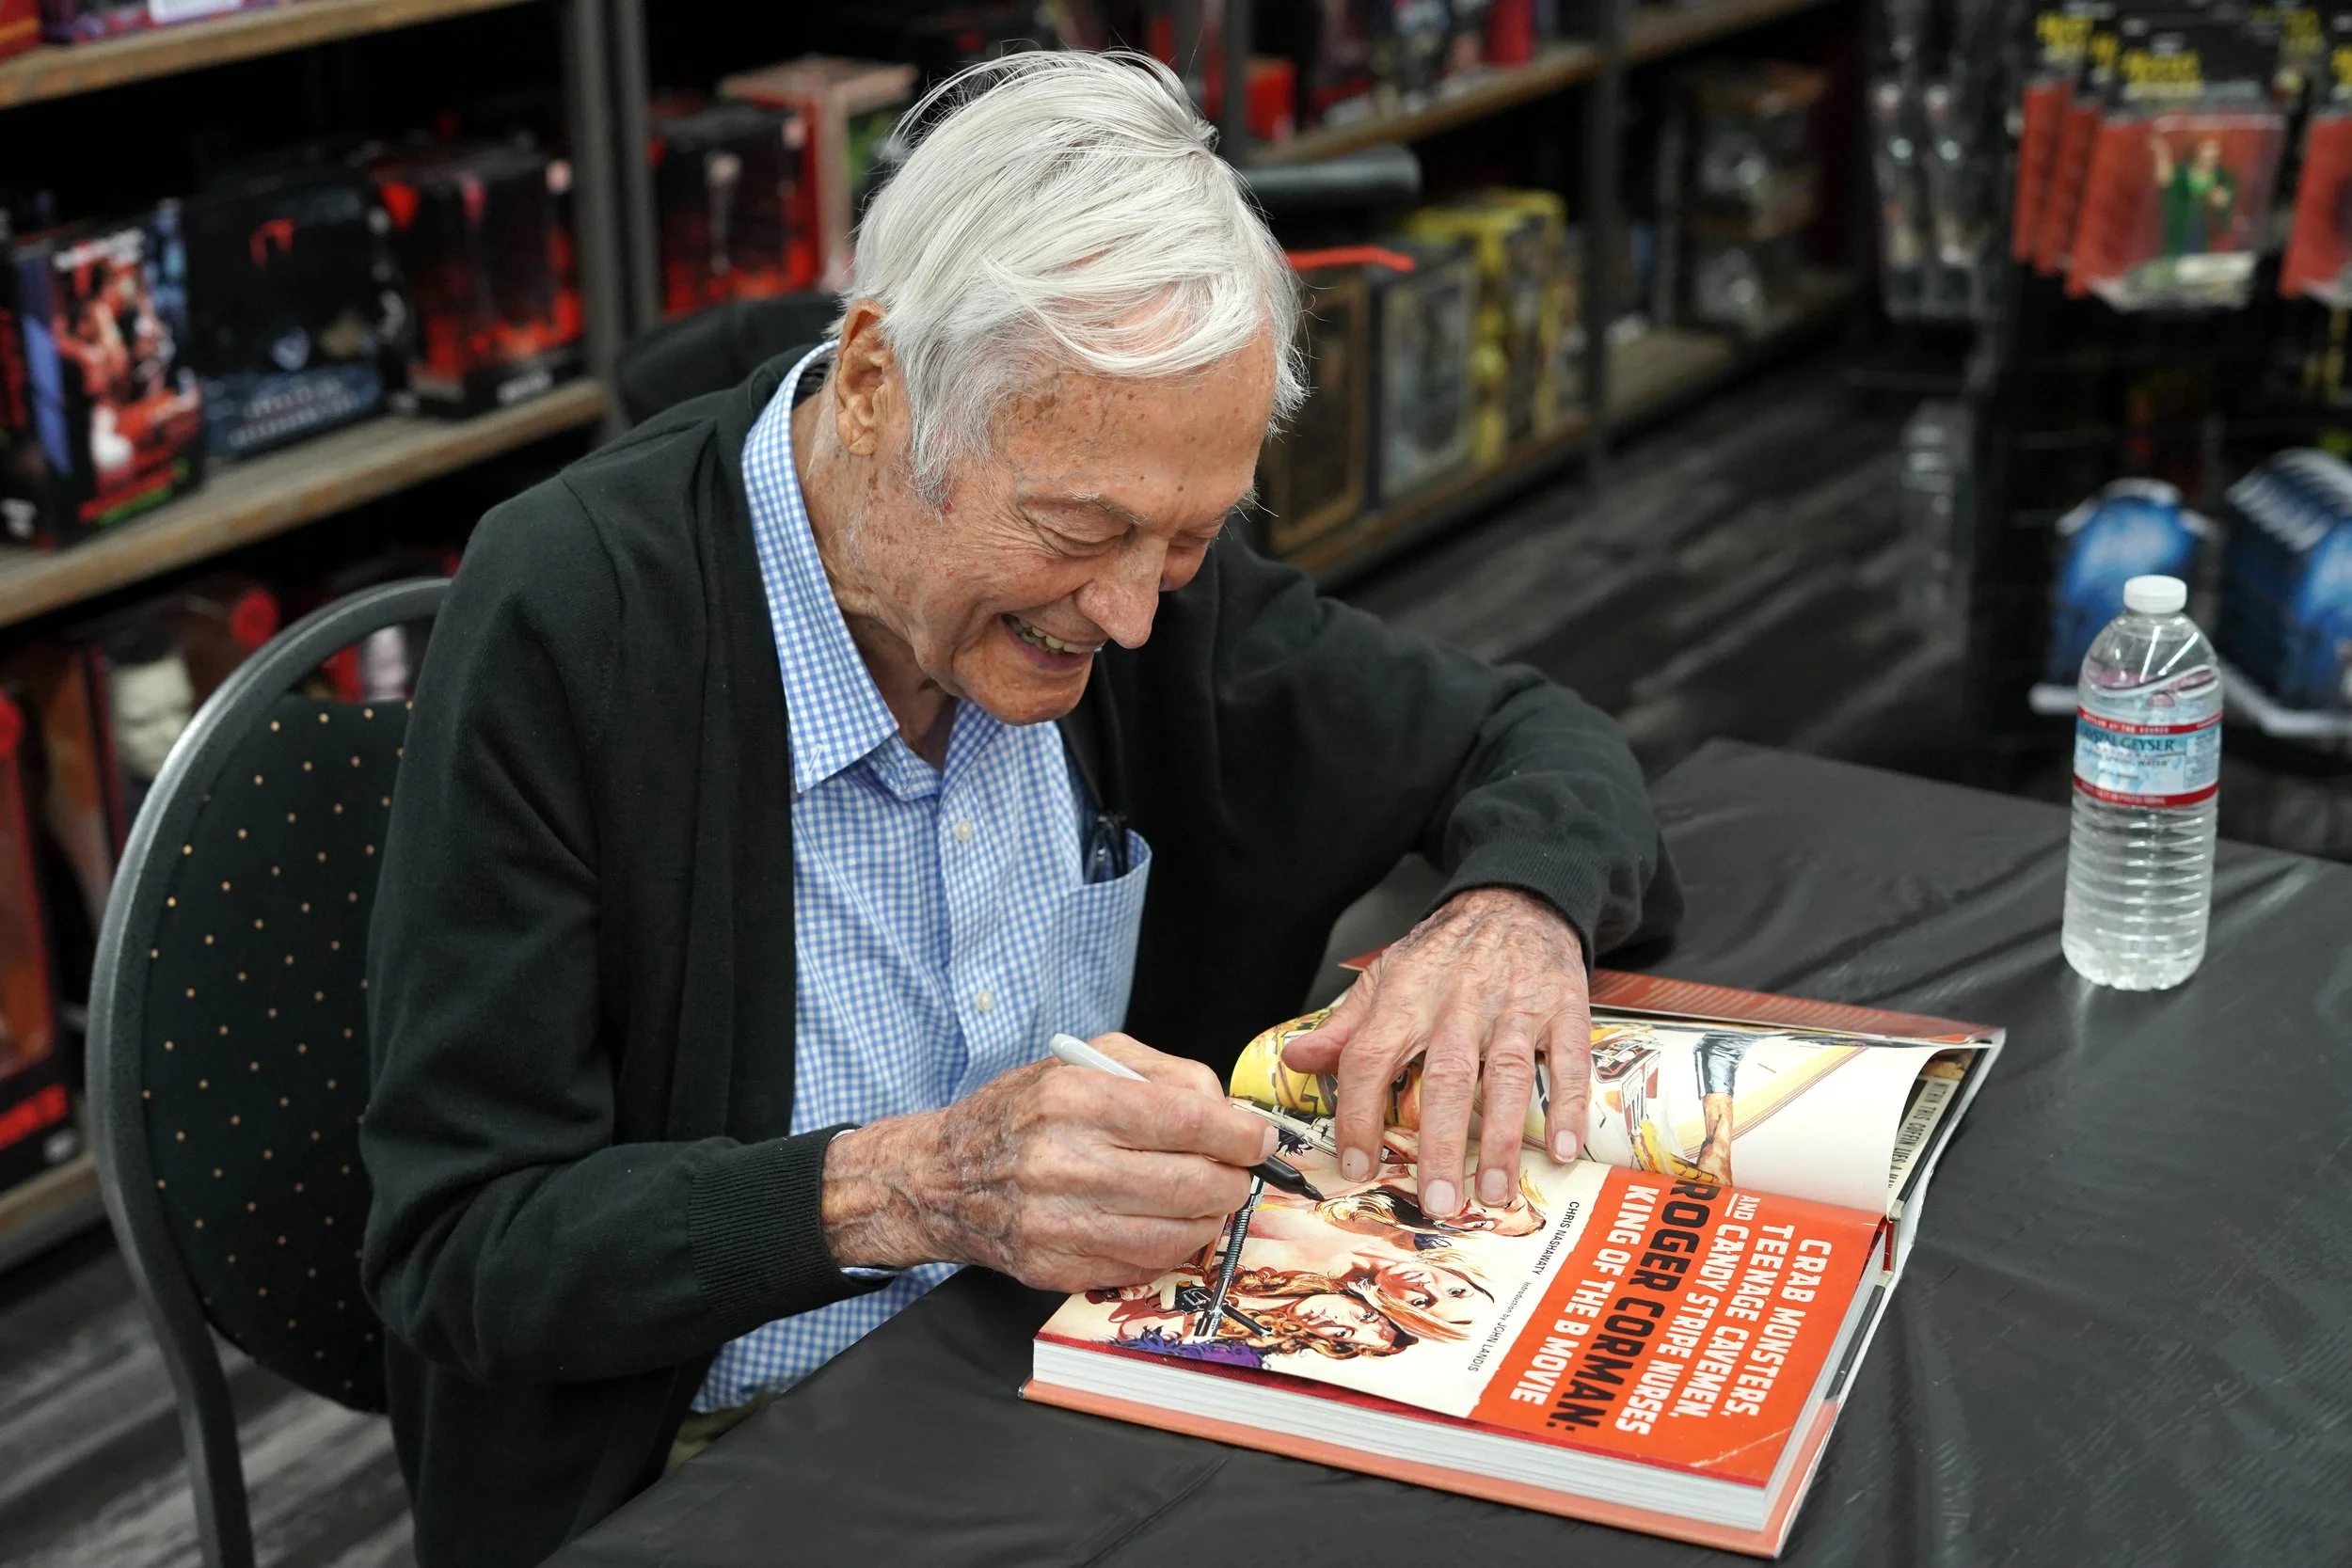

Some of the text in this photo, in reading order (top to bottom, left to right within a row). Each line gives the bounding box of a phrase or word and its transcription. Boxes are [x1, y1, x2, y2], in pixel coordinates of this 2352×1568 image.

[2120, 736, 2175, 752] GEYSER
[1898, 1122, 1927, 1147] COFFIN
[1913, 1105, 1937, 1121] THIS
[1532, 1201, 1580, 1275] CHRIS NASHAWATY
[1506, 1281, 1532, 1315] Introduction
[1509, 1184, 1661, 1405] KING OF THE B MOVIE
[1546, 1180, 1722, 1431] ROGER CORMAN:
[1614, 1195, 1761, 1435] AND CANDY STRIPE NURSES
[1668, 1224, 1796, 1418] TEENAGE CAVEMEN,
[1489, 1322, 1507, 1348] JOHN
[1719, 1239, 1833, 1417] CRAB MONSTERS,
[1468, 1342, 1495, 1372] LANDIS
